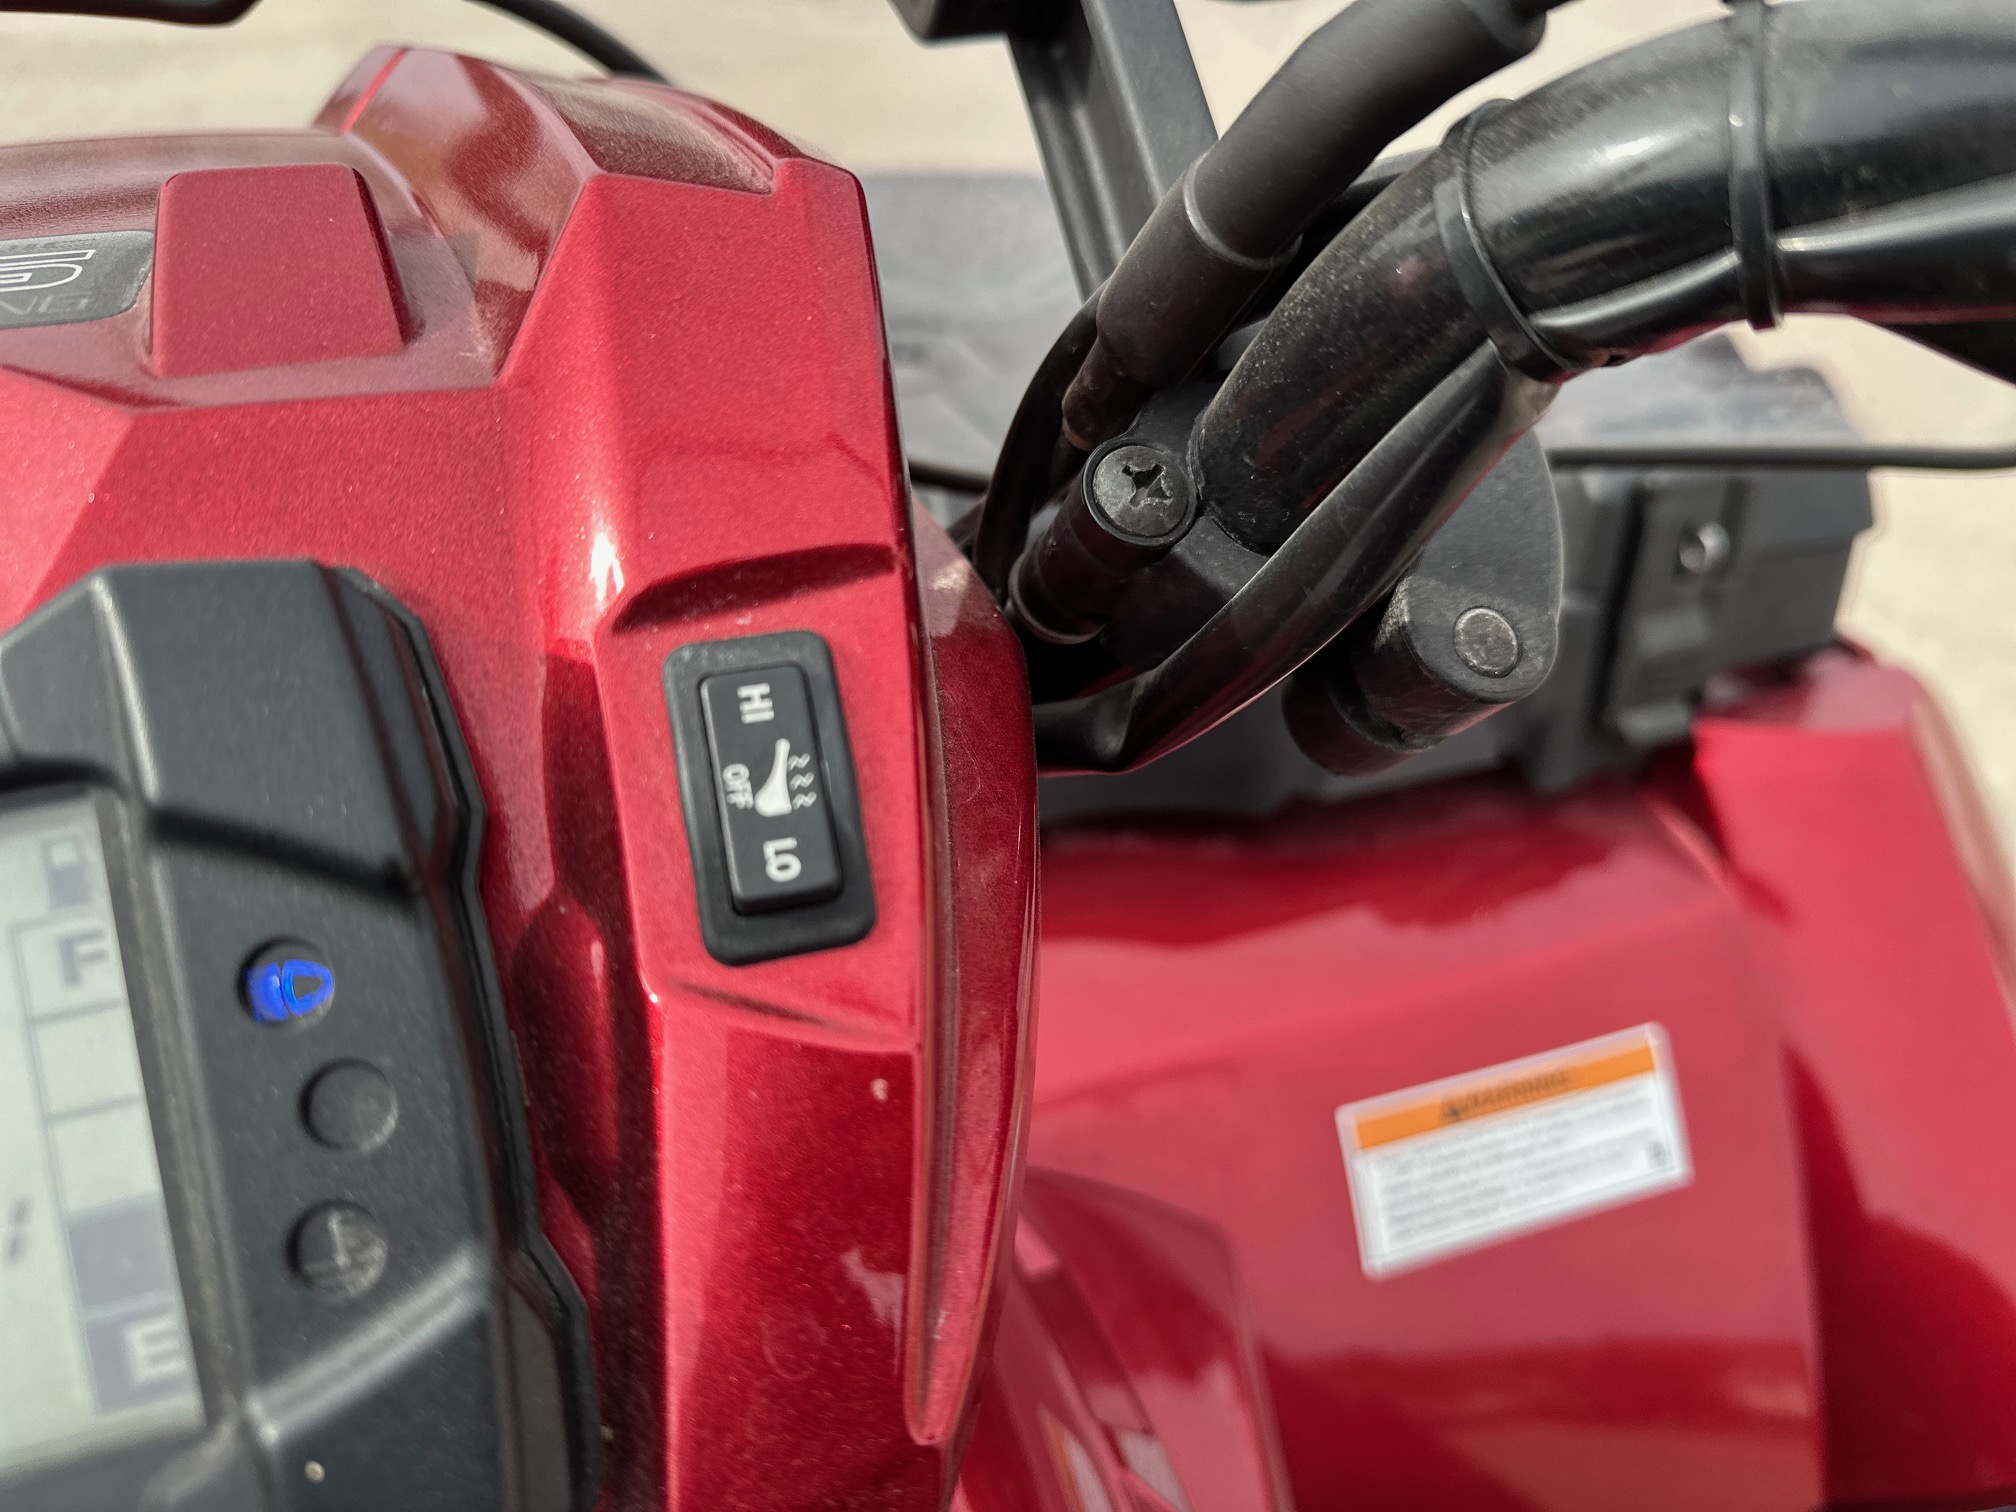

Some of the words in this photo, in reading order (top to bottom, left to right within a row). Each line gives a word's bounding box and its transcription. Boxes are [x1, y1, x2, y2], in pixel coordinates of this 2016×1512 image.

[737, 682, 775, 724] HI
[722, 763, 754, 809] OFF
[762, 836, 802, 882] LO
[57, 928, 107, 987] F
[122, 1313, 188, 1384] E
